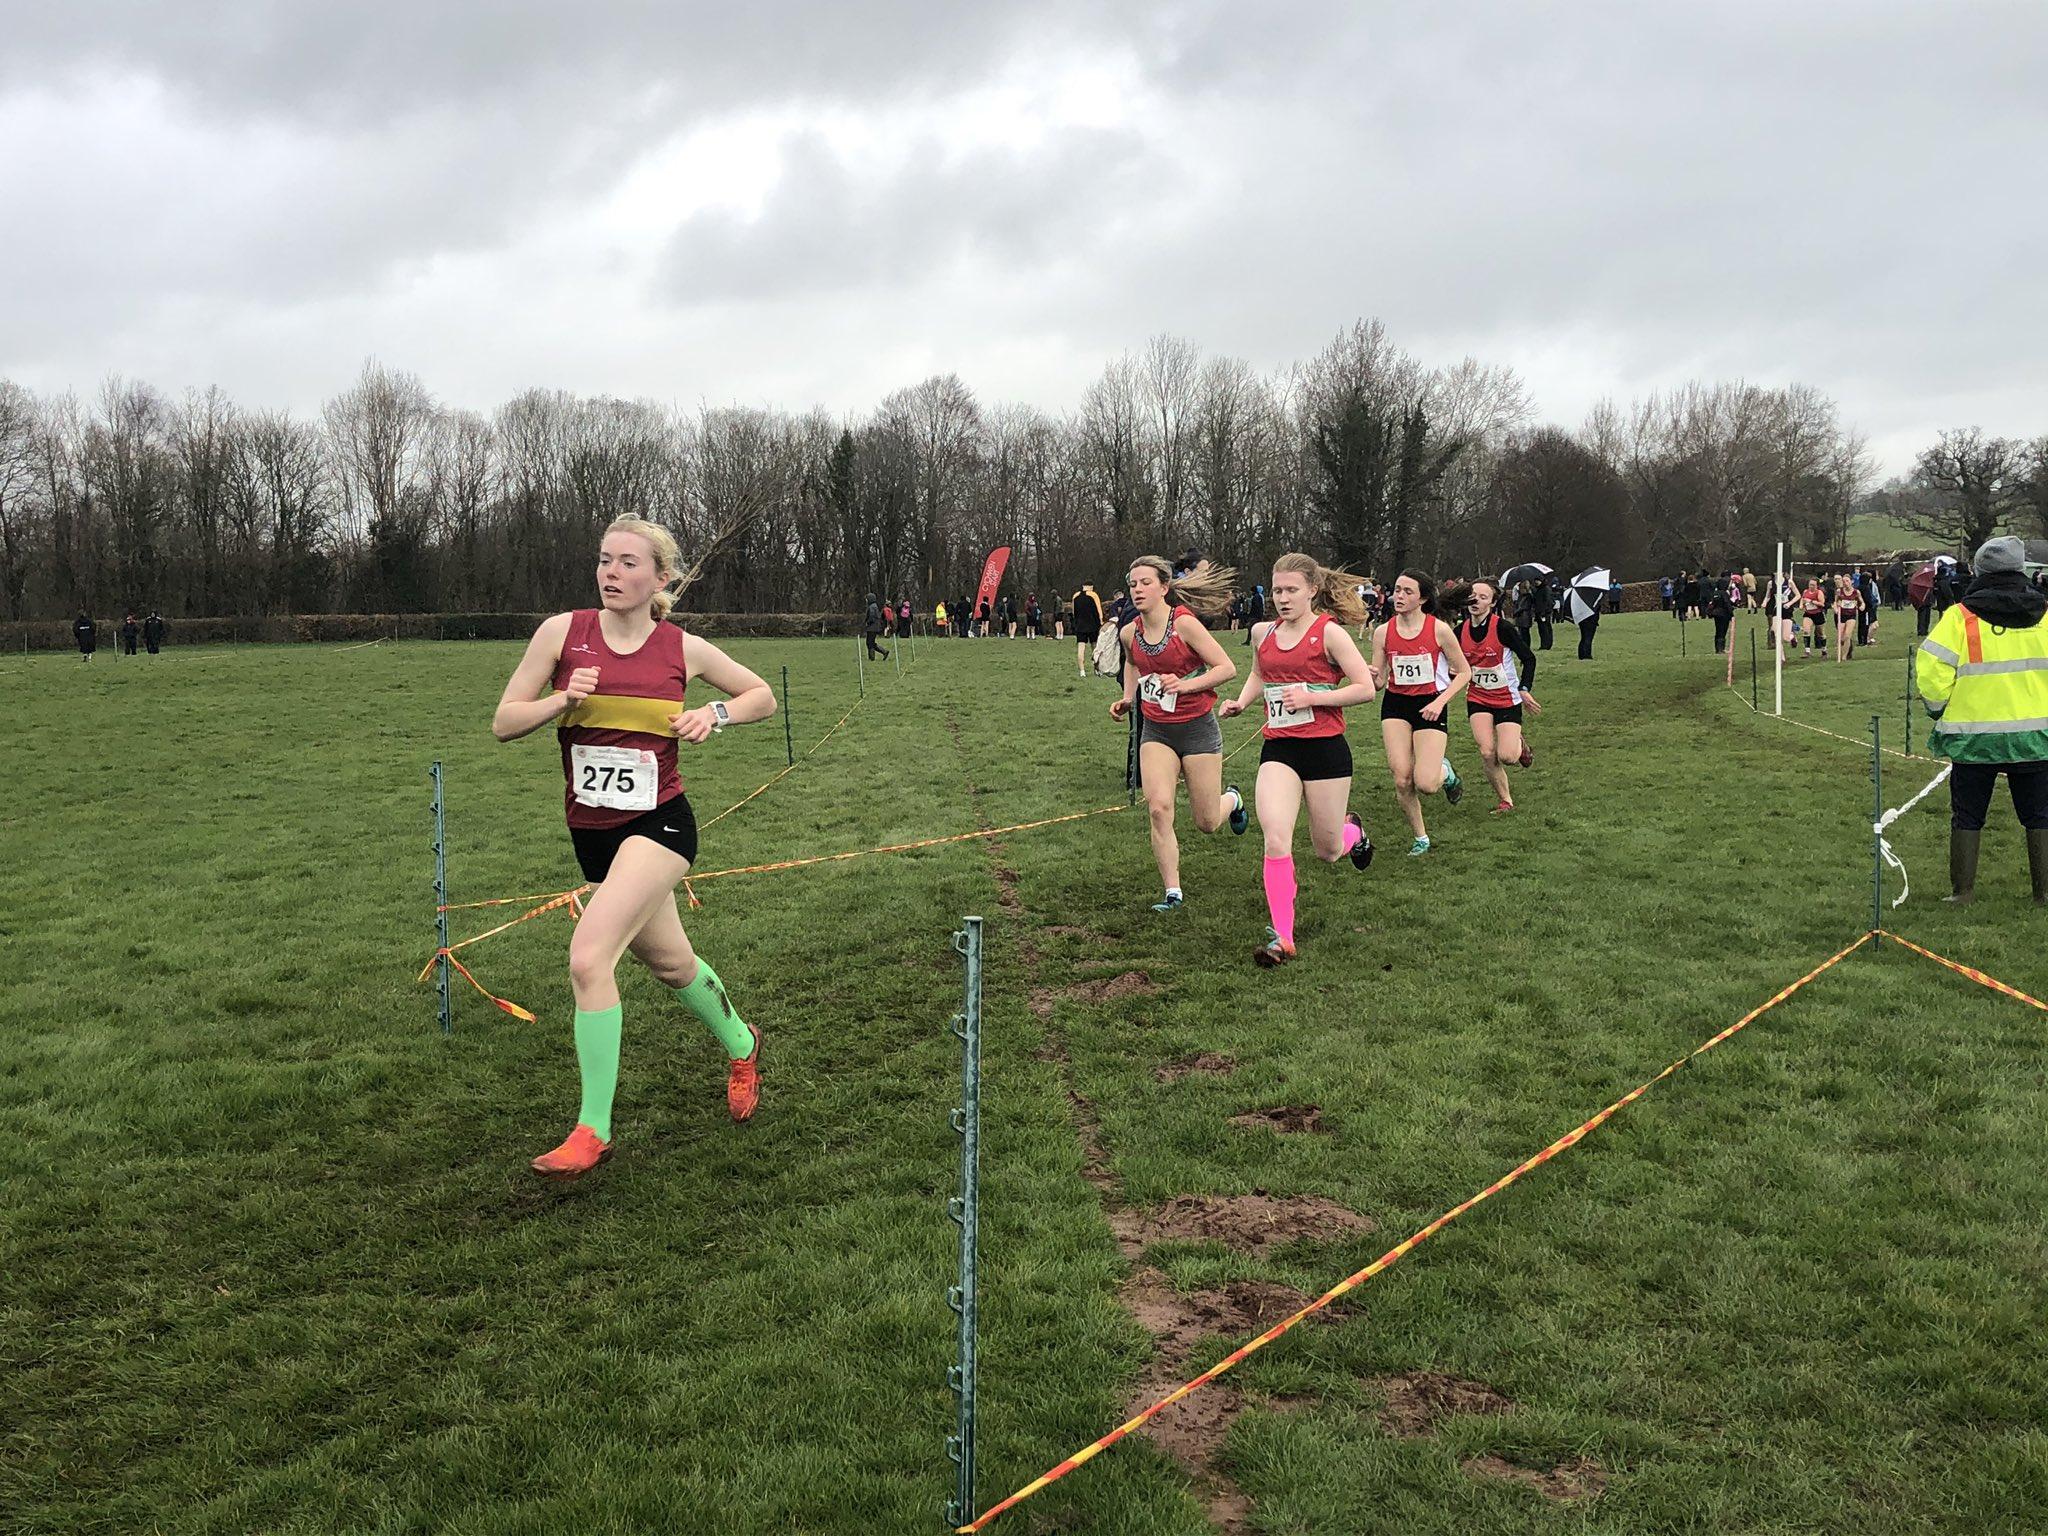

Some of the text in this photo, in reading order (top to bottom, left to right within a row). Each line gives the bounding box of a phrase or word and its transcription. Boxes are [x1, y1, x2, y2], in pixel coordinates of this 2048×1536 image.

[1397, 664, 1421, 678] 781
[1474, 673, 1499, 684] 773
[1144, 679, 1165, 700] 874
[1269, 700, 1297, 717] 87
[582, 765, 635, 794] 275
